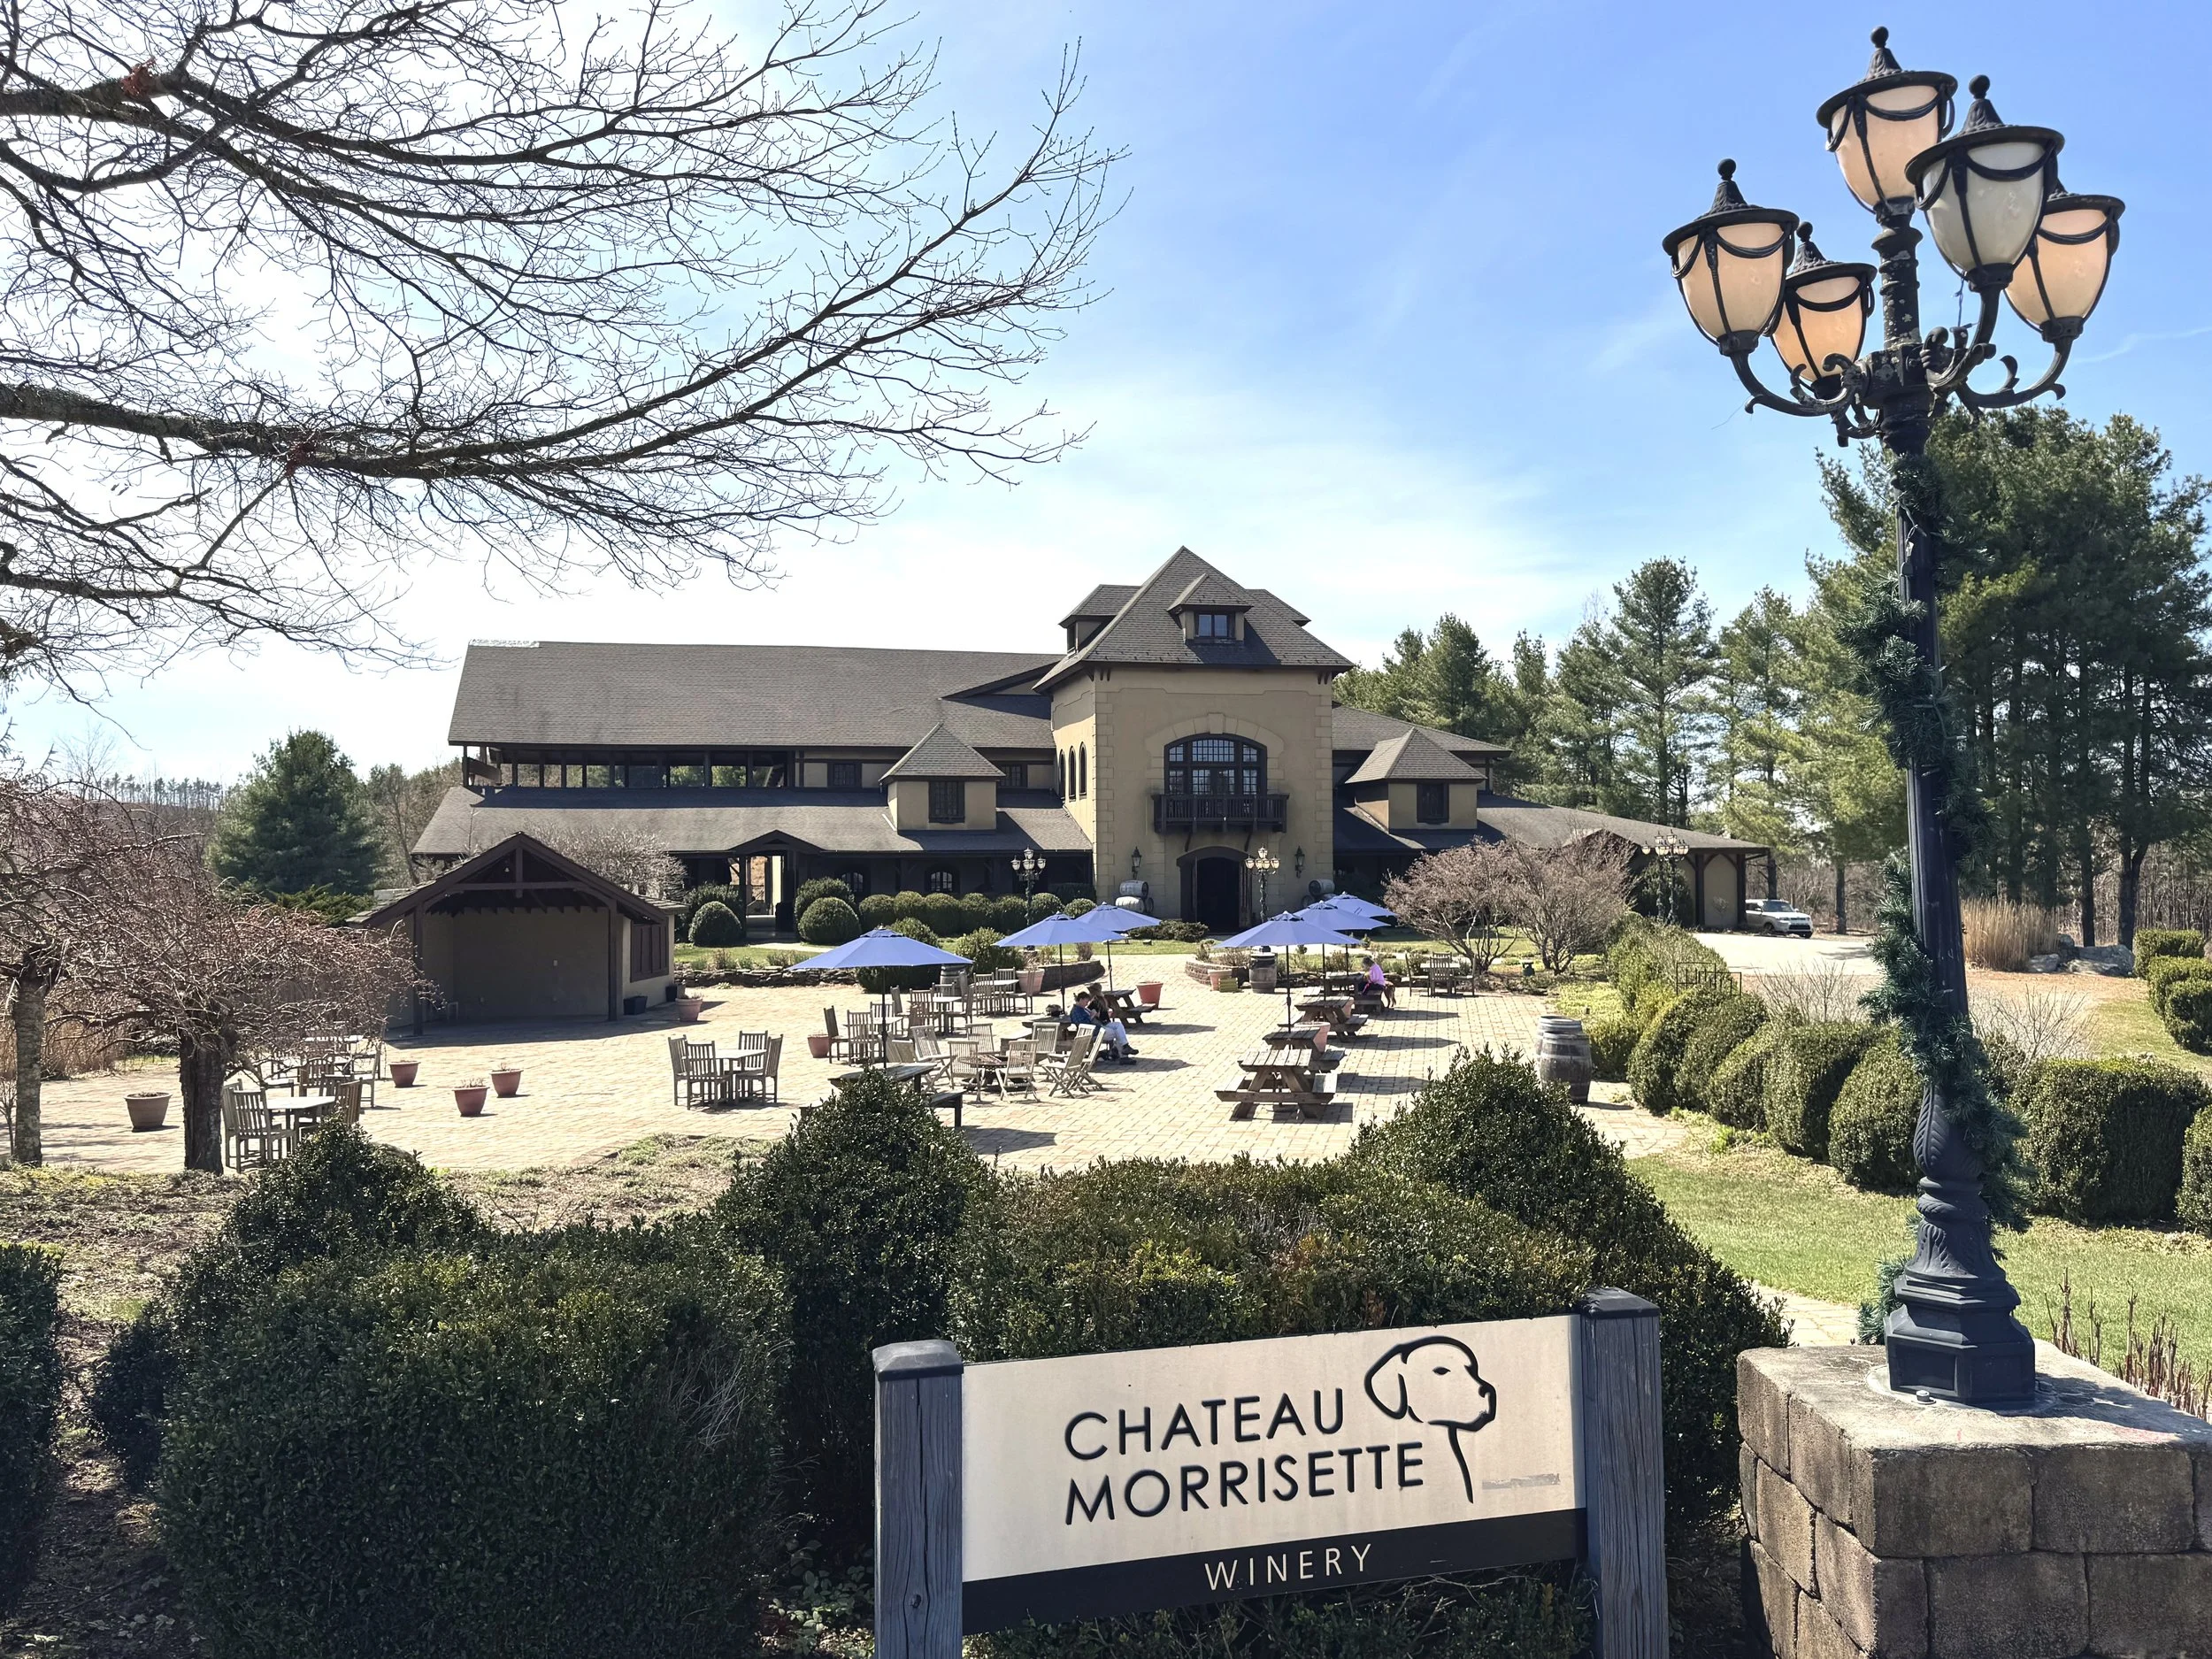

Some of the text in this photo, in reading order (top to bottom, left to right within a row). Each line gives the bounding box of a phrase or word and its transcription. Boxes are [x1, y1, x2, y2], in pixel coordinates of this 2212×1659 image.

[1064, 1388, 1344, 1461] CHATEAU
[1064, 1441, 1424, 1526] MORRISETTE
[1204, 1542, 1373, 1591] WINERY
